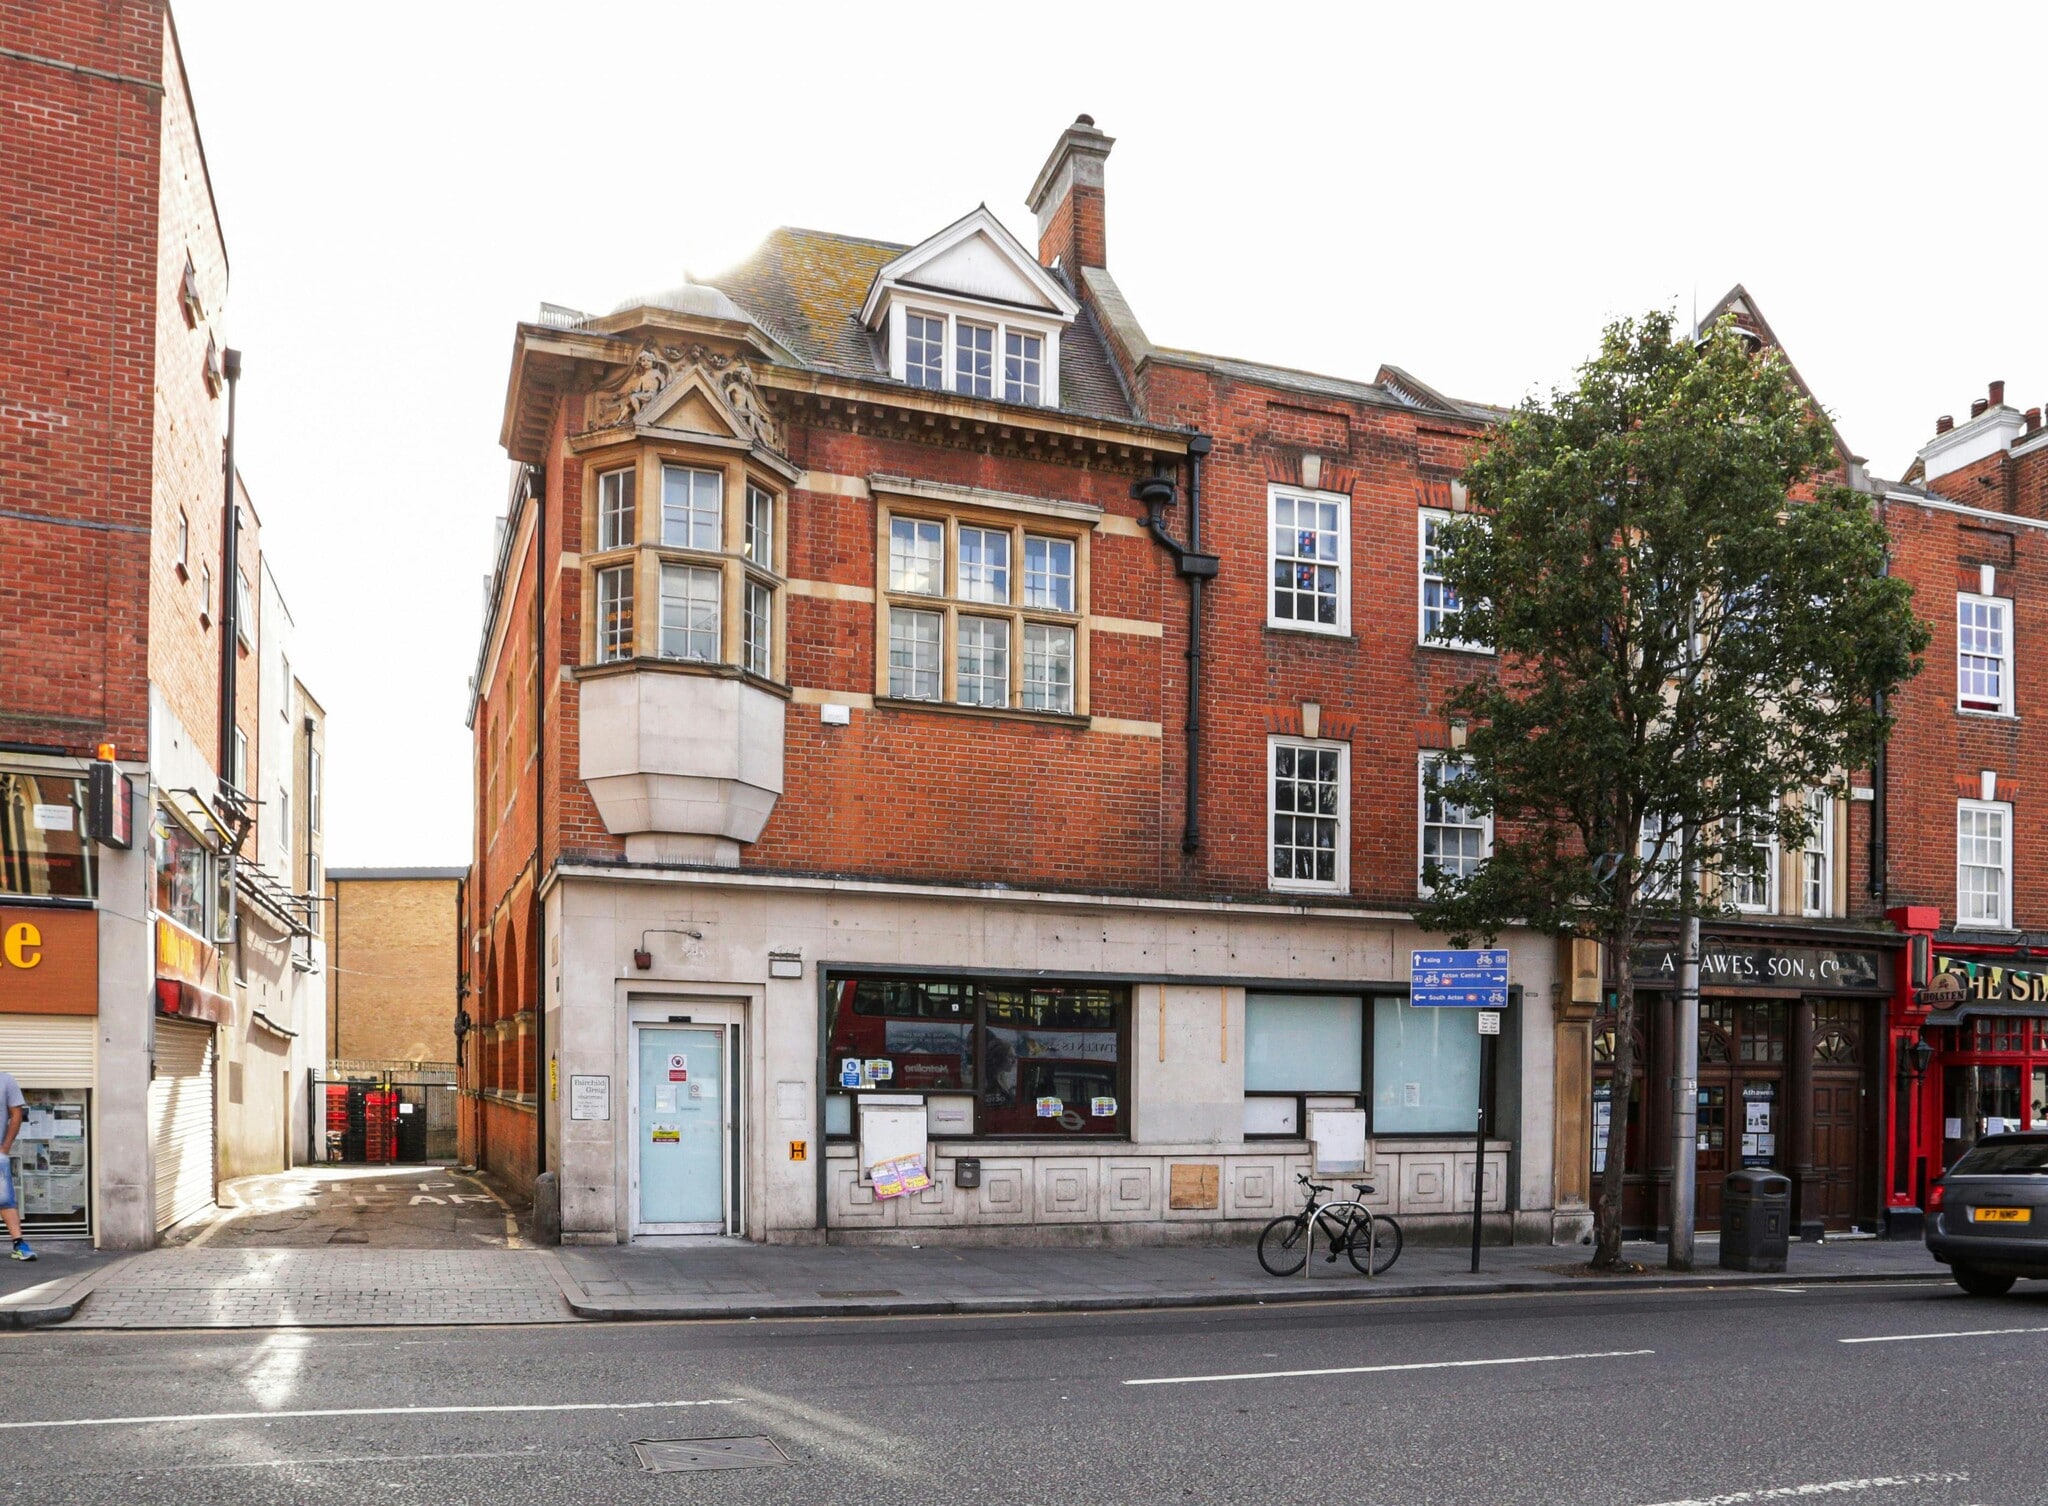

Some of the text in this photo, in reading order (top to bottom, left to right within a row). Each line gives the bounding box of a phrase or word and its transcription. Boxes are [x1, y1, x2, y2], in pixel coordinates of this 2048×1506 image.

[1768, 957, 1804, 977] SON
[1922, 990, 1964, 1001] HOLSTEN
[1742, 1088, 1774, 1096] Athawes
[791, 1142, 804, 1159] H
